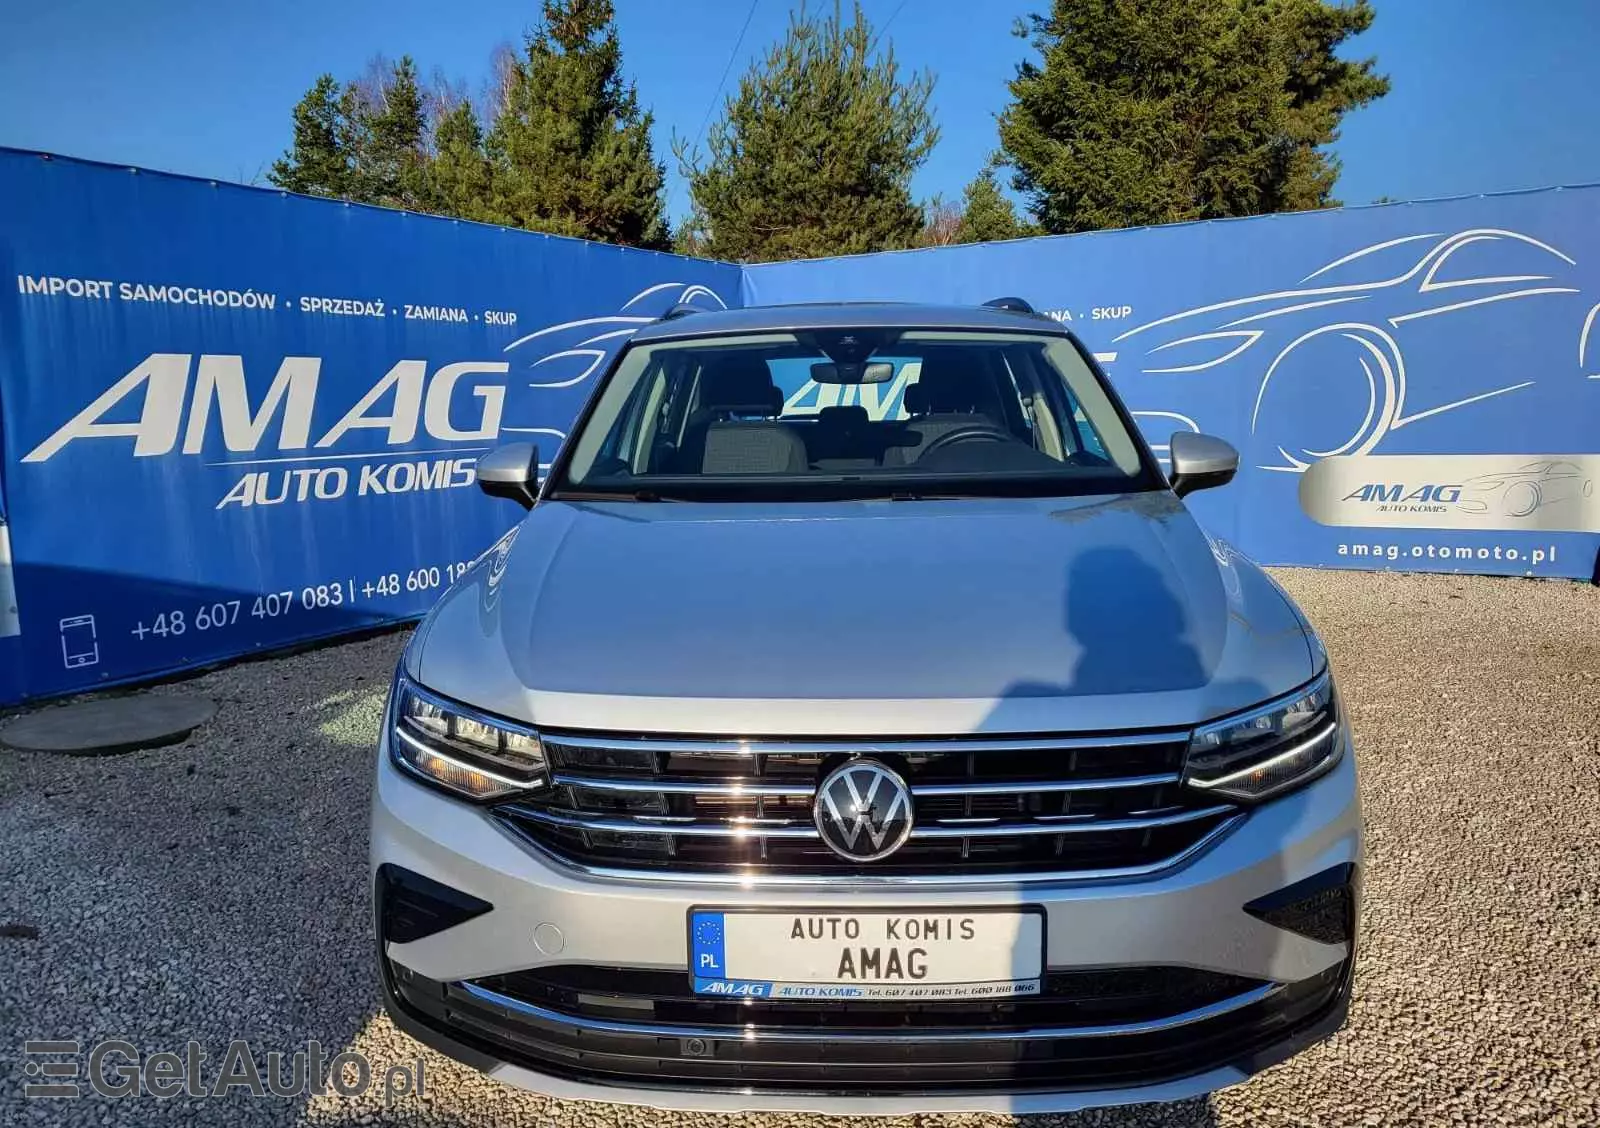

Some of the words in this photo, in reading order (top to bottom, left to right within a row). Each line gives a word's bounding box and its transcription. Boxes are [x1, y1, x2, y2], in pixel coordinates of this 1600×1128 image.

[17, 275, 113, 299] IMPORT
[119, 283, 276, 310] SAMOCHODÓW
[300, 297, 385, 317] SPRZEDAŻ
[404, 304, 469, 323] ZAMIANA
[484, 310, 517, 325] SKUP
[1091, 306, 1132, 320] SKUP
[20, 353, 509, 463] AMAG
[215, 467, 347, 510] AUTO
[358, 457, 477, 496] KOMIS
[1341, 484, 1463, 503] AMAG
[1376, 504, 1408, 513] AUTO
[1409, 504, 1448, 513] KOMIS
[1337, 542, 1556, 565] amag.otomoto.pl
[131, 609, 186, 641] +48
[195, 600, 241, 631] 607
[251, 590, 294, 620] 407
[302, 583, 342, 611] 083
[361, 573, 400, 599] +48
[406, 566, 440, 592] 600
[446, 560, 475, 584] 18
[790, 918, 860, 940] AUTO
[886, 918, 975, 940] KOMIS
[700, 953, 719, 969] PL
[837, 947, 928, 980] AMAG
[701, 982, 765, 996] AMAG
[779, 987, 815, 996] AUTO
[818, 988, 864, 997] KOMIS
